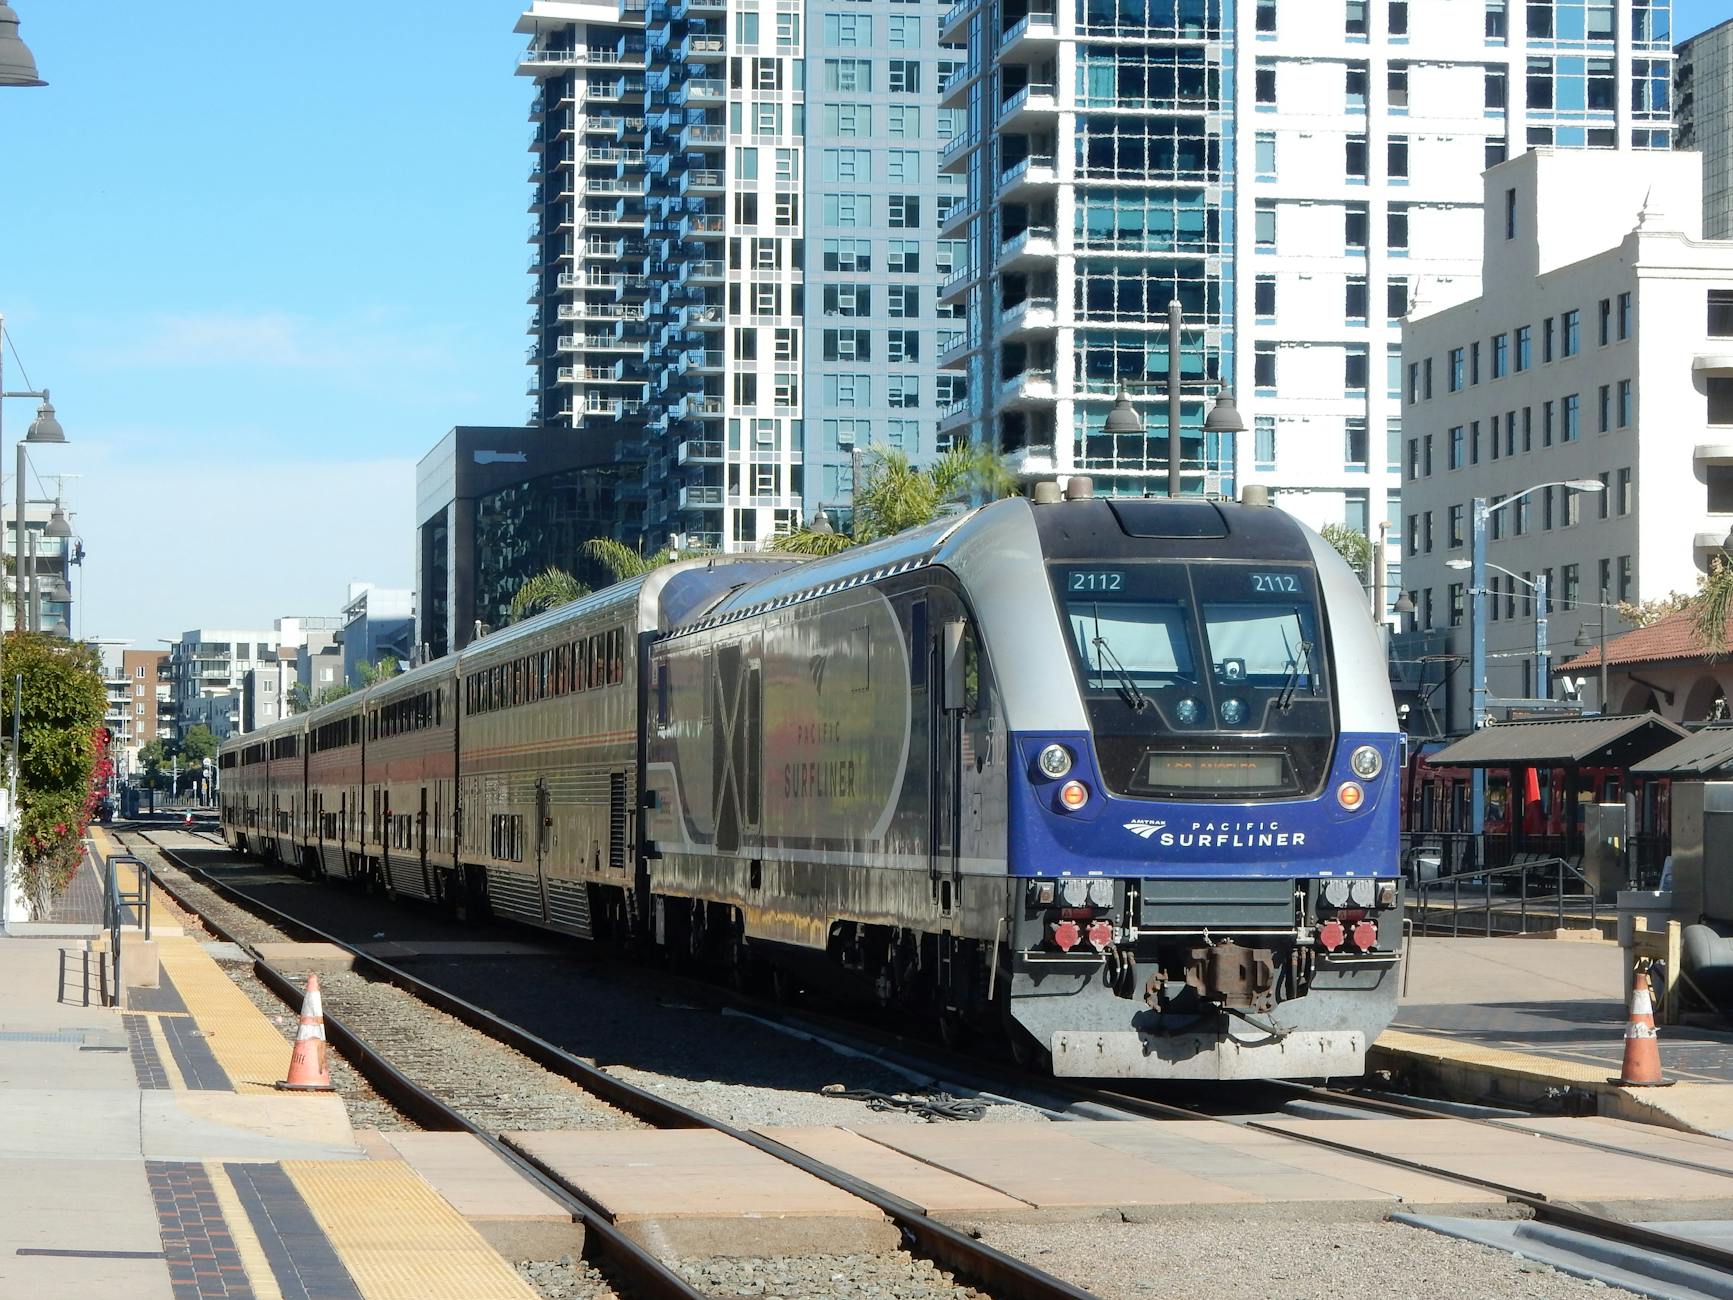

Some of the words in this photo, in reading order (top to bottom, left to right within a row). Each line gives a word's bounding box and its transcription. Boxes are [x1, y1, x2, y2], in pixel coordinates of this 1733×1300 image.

[1073, 574, 1121, 590] 2112
[1252, 575, 1297, 592] 2112
[798, 721, 840, 745] PACIFIC
[784, 761, 855, 798] SURFLINER
[1192, 822, 1279, 831] PACIFIC
[1160, 832, 1305, 847] SURFLINER
